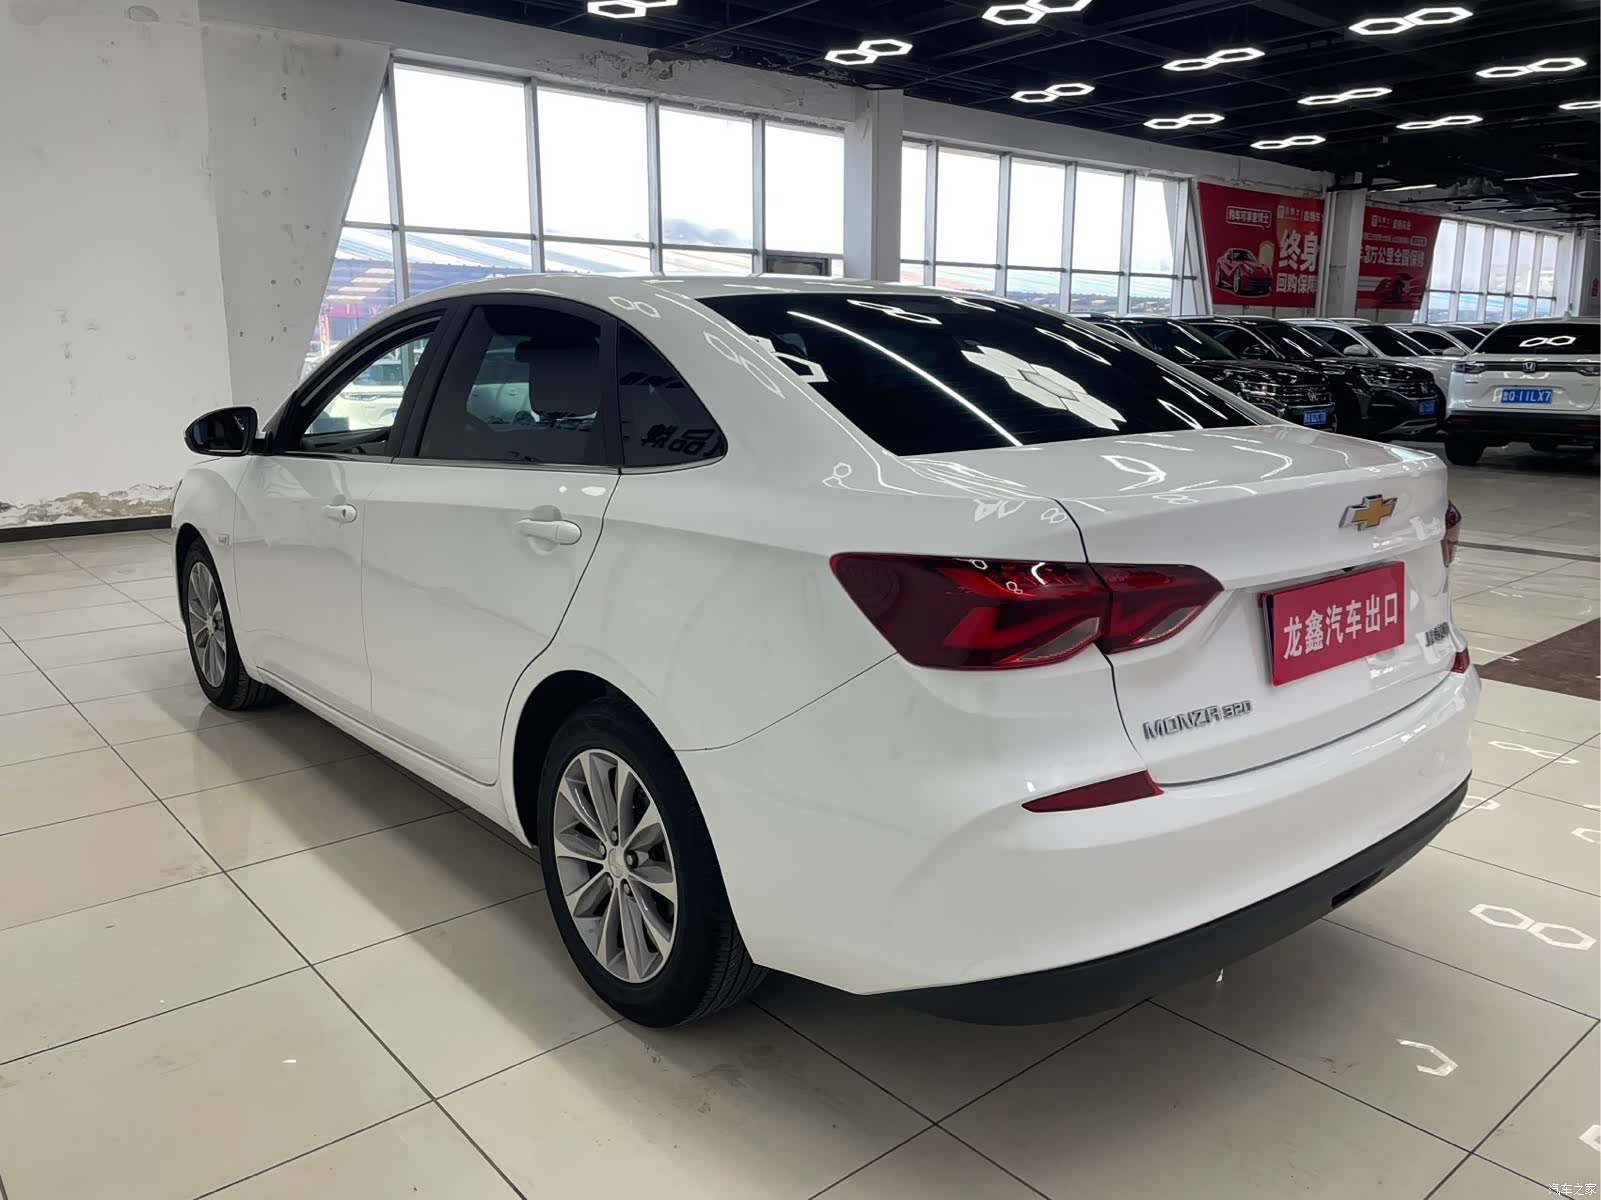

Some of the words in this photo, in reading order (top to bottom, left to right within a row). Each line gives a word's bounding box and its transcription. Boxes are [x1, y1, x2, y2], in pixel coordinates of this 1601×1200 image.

[1278, 229, 1320, 272] 终身
[1283, 592, 1398, 660] 龙鑫汽车出口
[1221, 700, 1253, 720] 320
